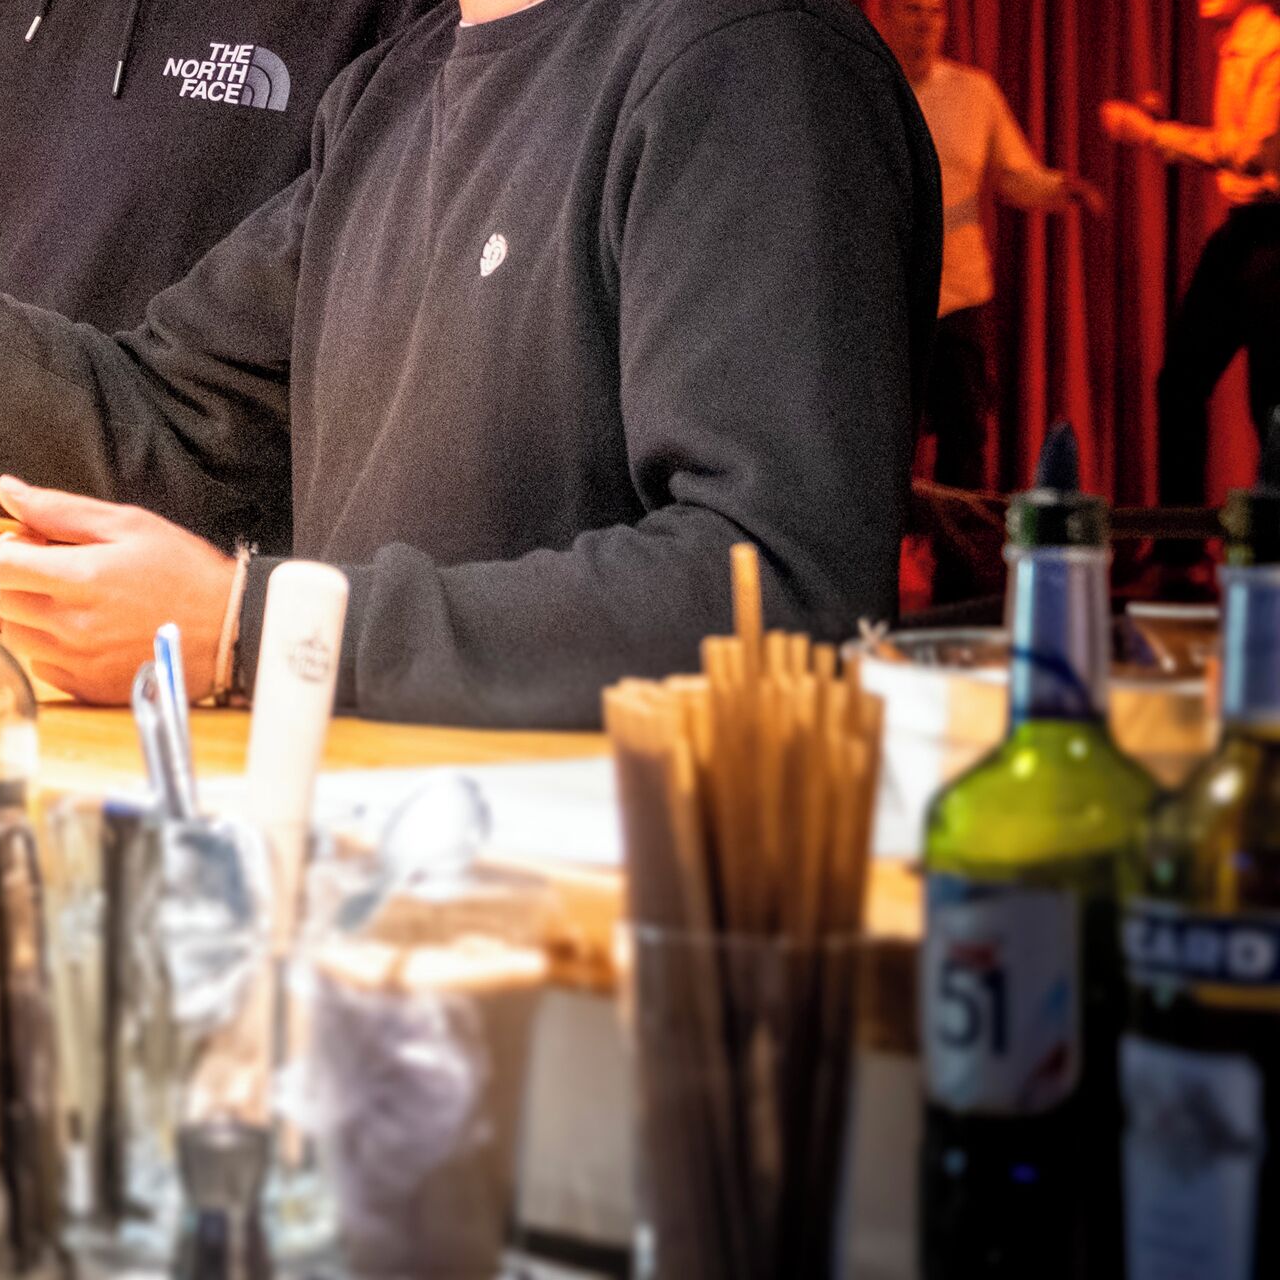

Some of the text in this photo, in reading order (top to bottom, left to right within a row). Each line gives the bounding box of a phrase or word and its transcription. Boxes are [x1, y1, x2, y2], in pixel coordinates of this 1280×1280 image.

[209, 42, 254, 64] THE
[162, 57, 249, 84] NORTH
[179, 78, 243, 105] FACE
[940, 961, 1008, 1056] 51
